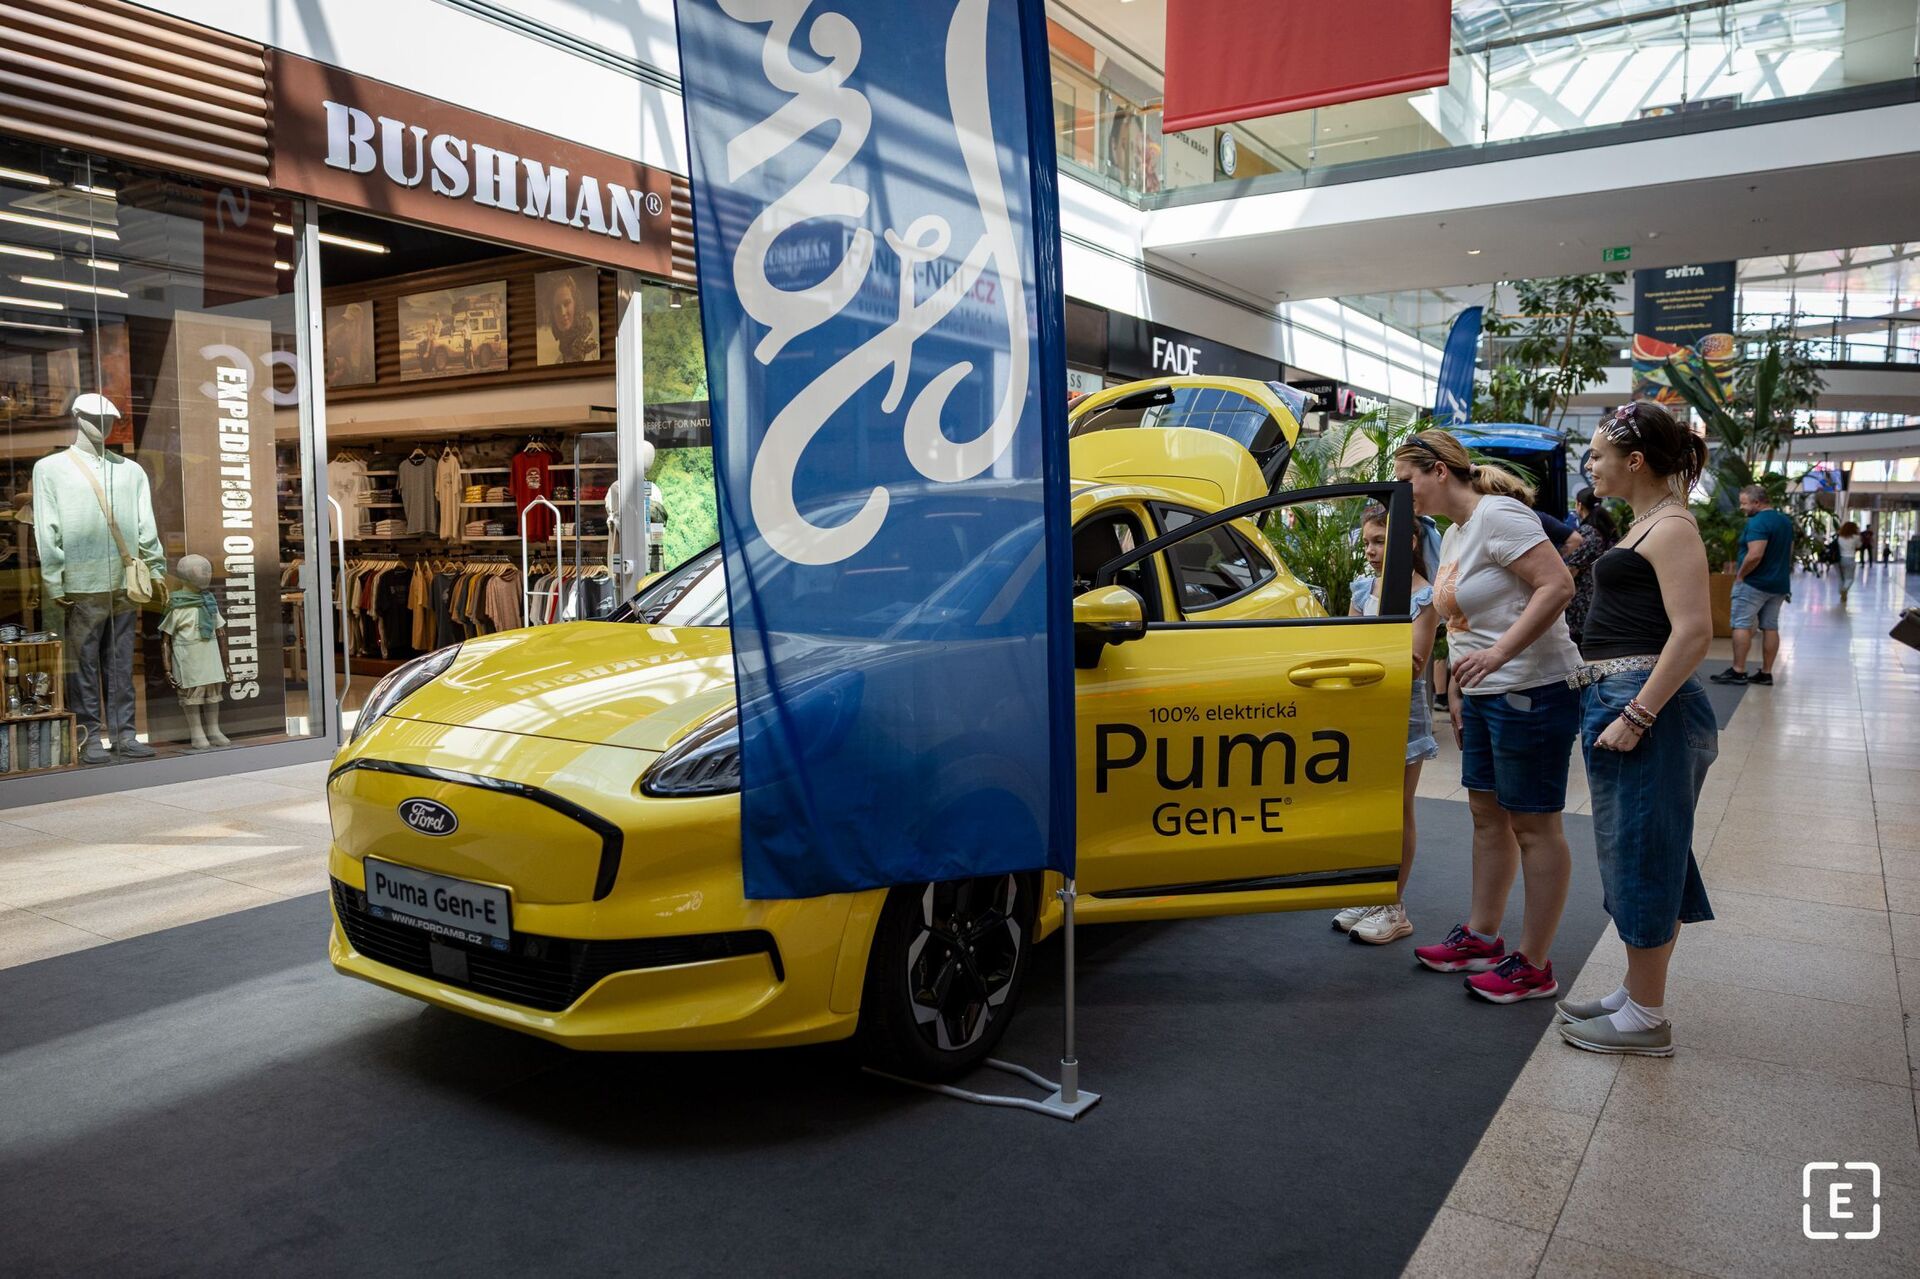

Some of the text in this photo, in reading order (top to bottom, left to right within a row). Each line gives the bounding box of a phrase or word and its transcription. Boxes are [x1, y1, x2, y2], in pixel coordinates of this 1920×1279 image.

[323, 100, 645, 243] BUSHMAN
[1665, 265, 1705, 279] SVĚTA
[1152, 336, 1202, 377] FADE
[690, 418, 712, 427] NATU
[216, 366, 260, 700] EXPEDITION OUTFITTERS
[1149, 701, 1297, 723] 100% elektrická
[1095, 723, 1350, 794] Puma
[408, 803, 445, 832] Ford
[1152, 797, 1284, 836] Gen-E
[375, 871, 497, 925] Puma Gen-E
